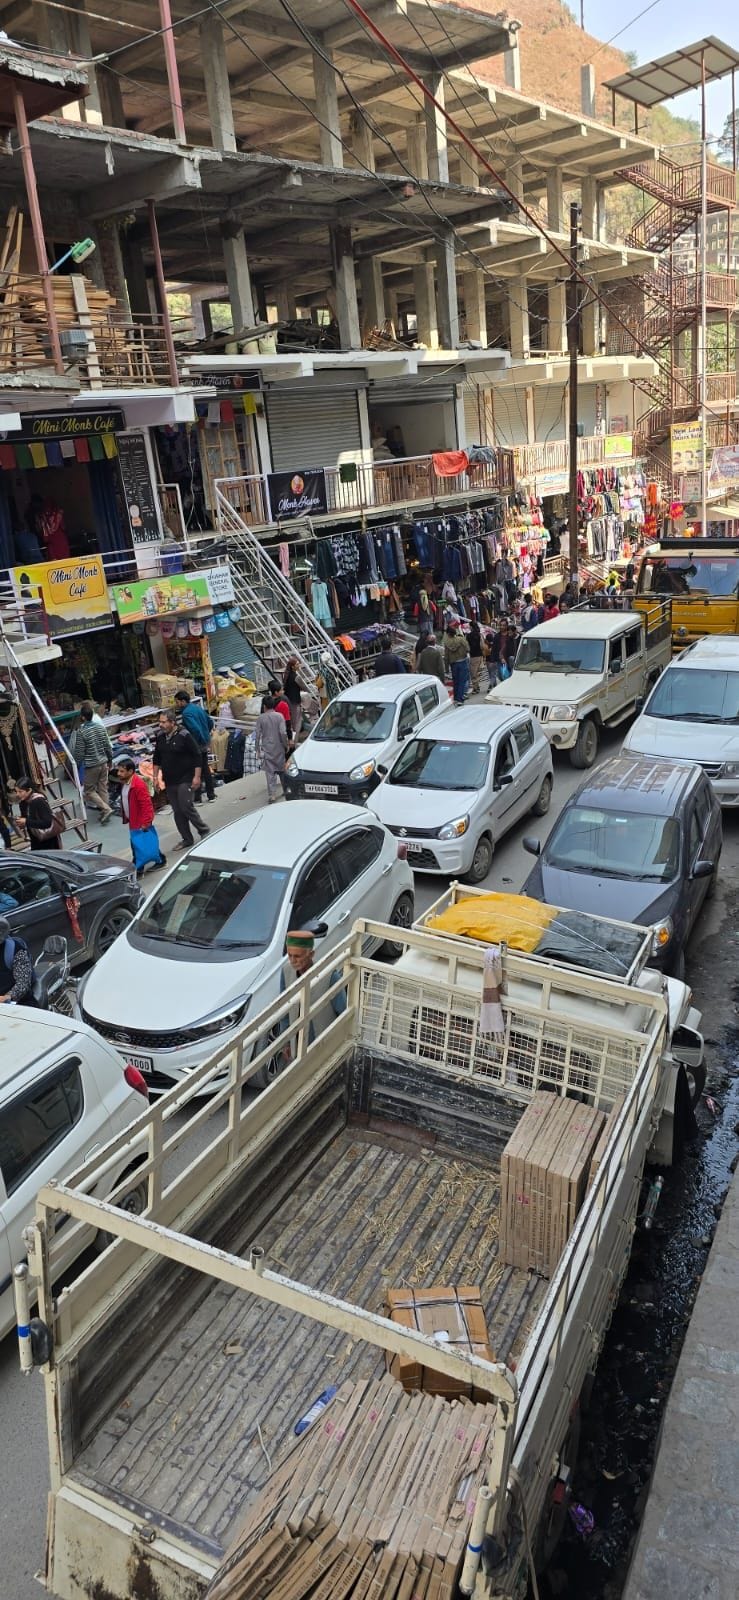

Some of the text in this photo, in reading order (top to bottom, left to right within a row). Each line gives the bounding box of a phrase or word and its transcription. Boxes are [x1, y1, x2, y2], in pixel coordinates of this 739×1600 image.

[33, 416, 115, 435] Mini Monk Café
[673, 425, 703, 436] New Look
[278, 498, 298, 511] Monk
[50, 565, 98, 584] Mini Monk
[69, 582, 87, 597] Café
